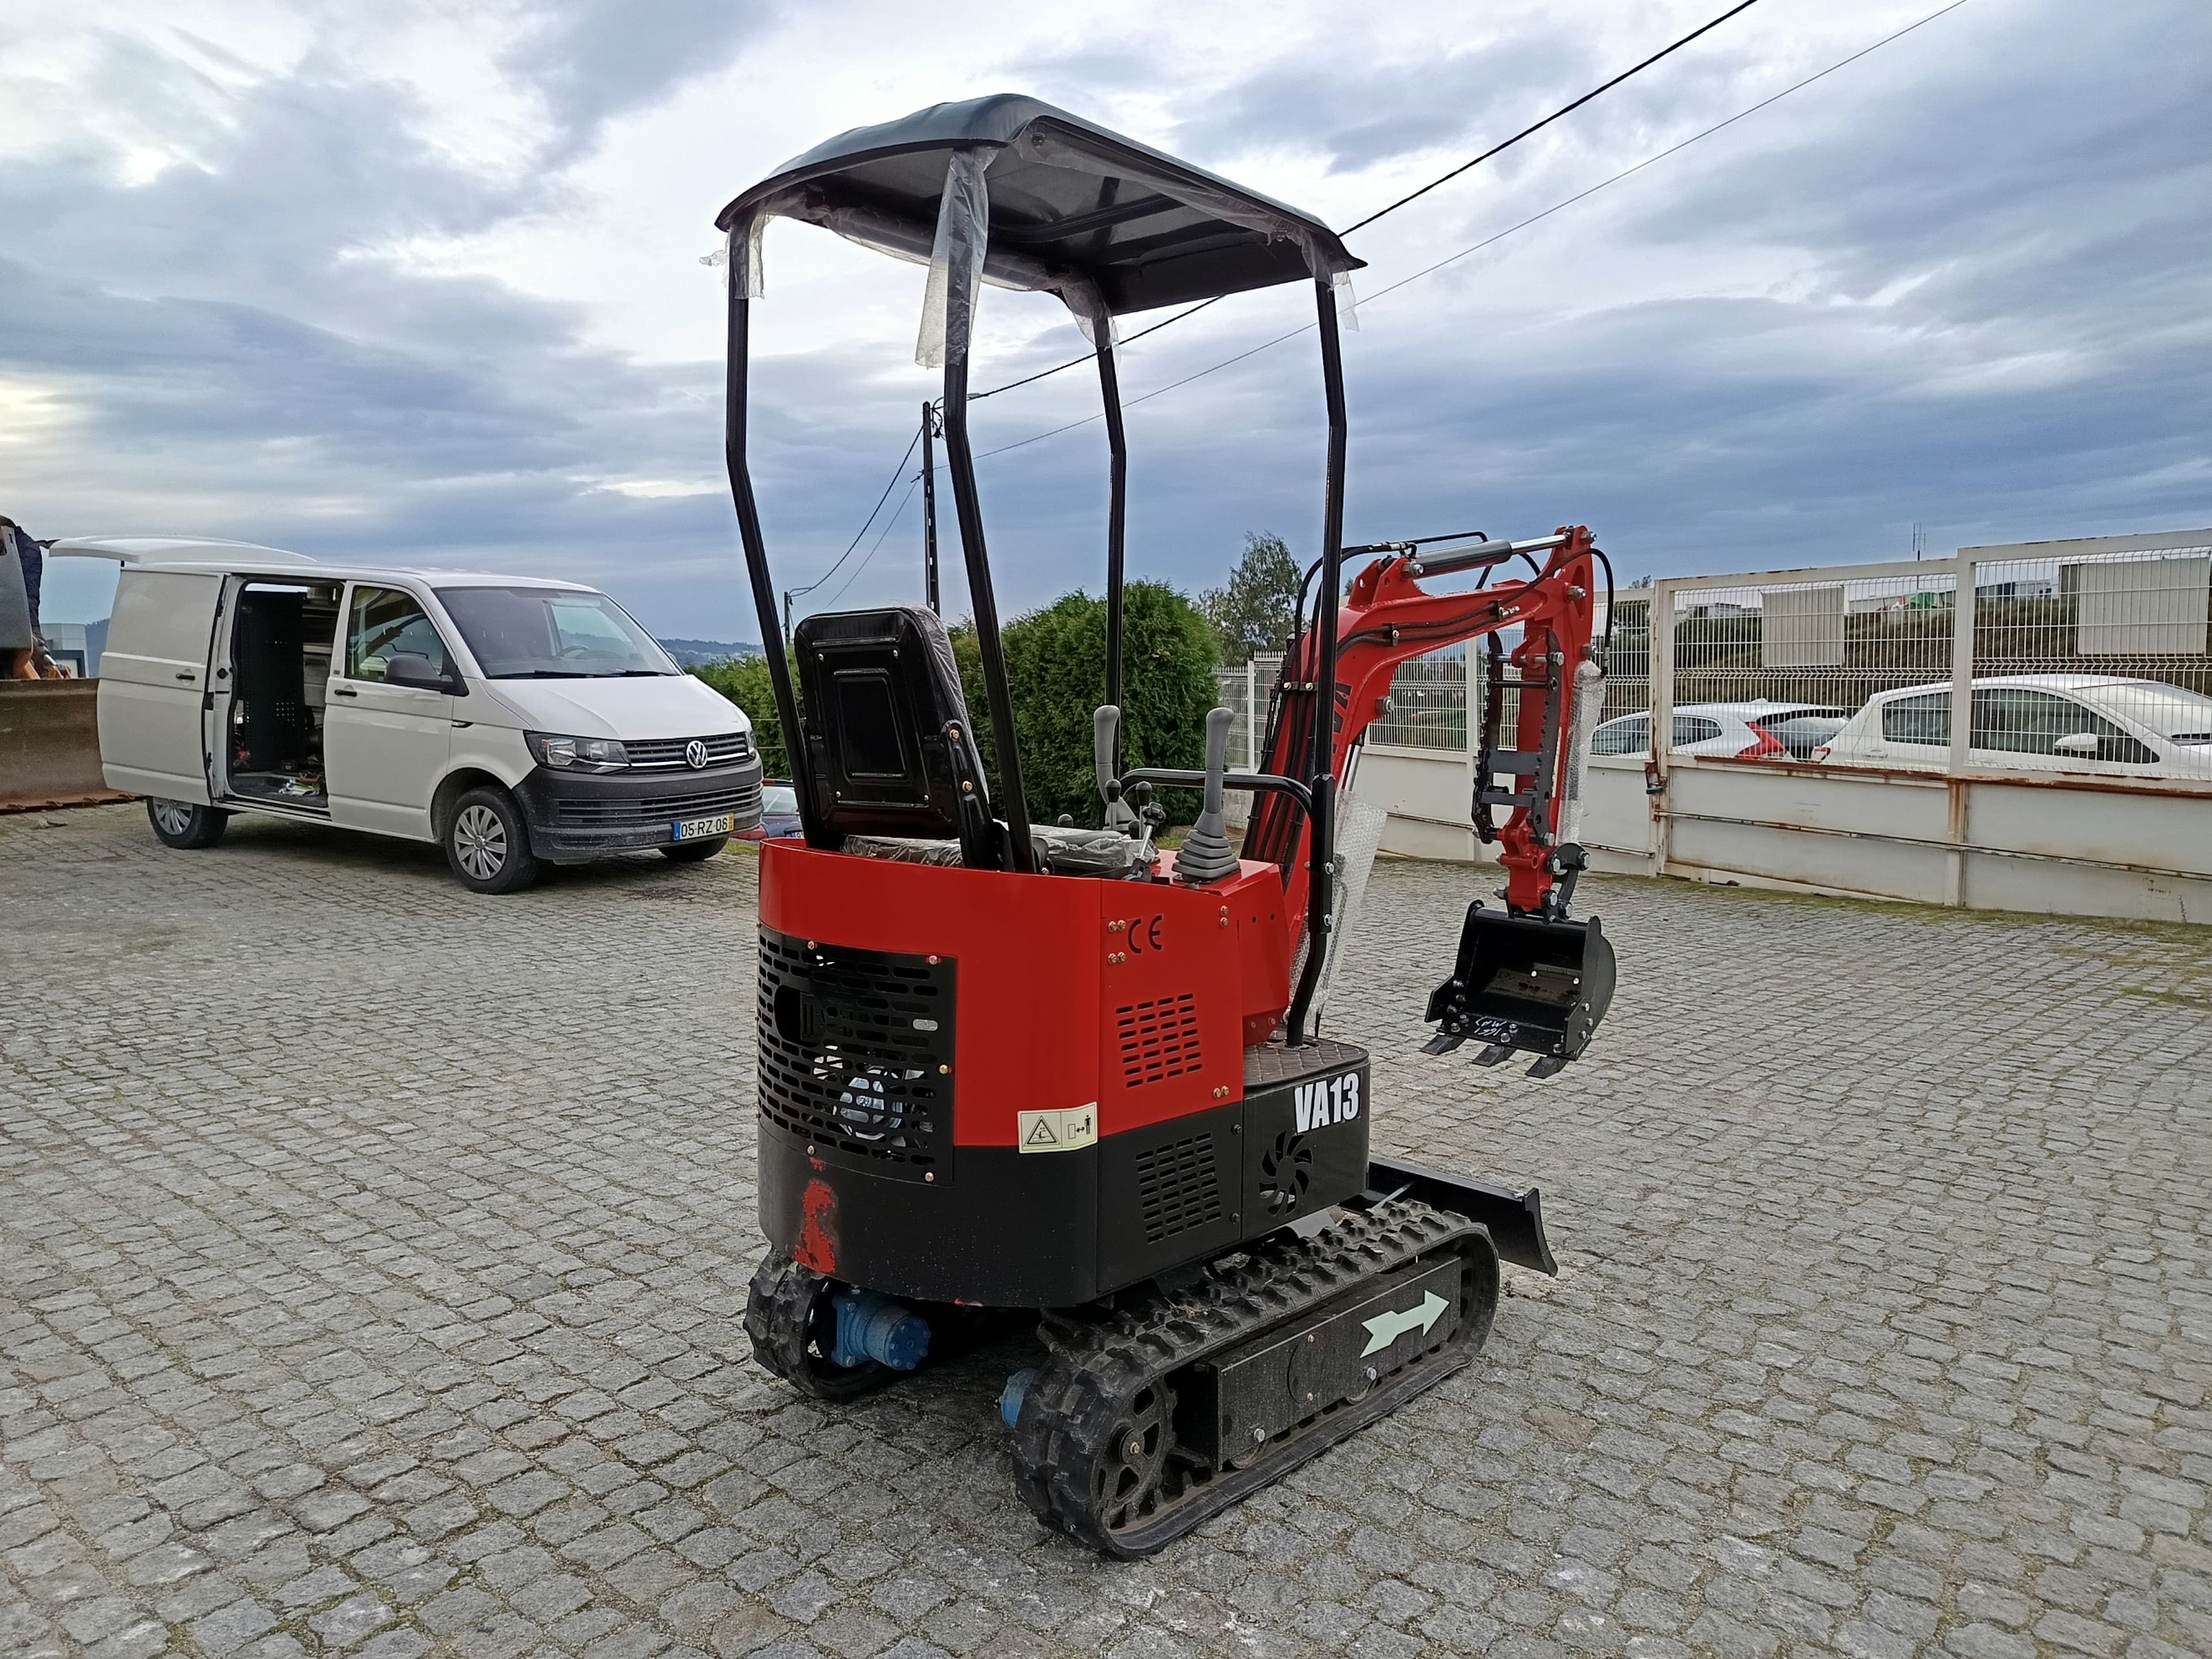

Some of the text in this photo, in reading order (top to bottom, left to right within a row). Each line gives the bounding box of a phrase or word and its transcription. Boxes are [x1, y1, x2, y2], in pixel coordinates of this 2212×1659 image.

[687, 740, 707, 768] VW
[1127, 914, 1163, 955] CE
[1294, 1073, 1359, 1134] VA13
